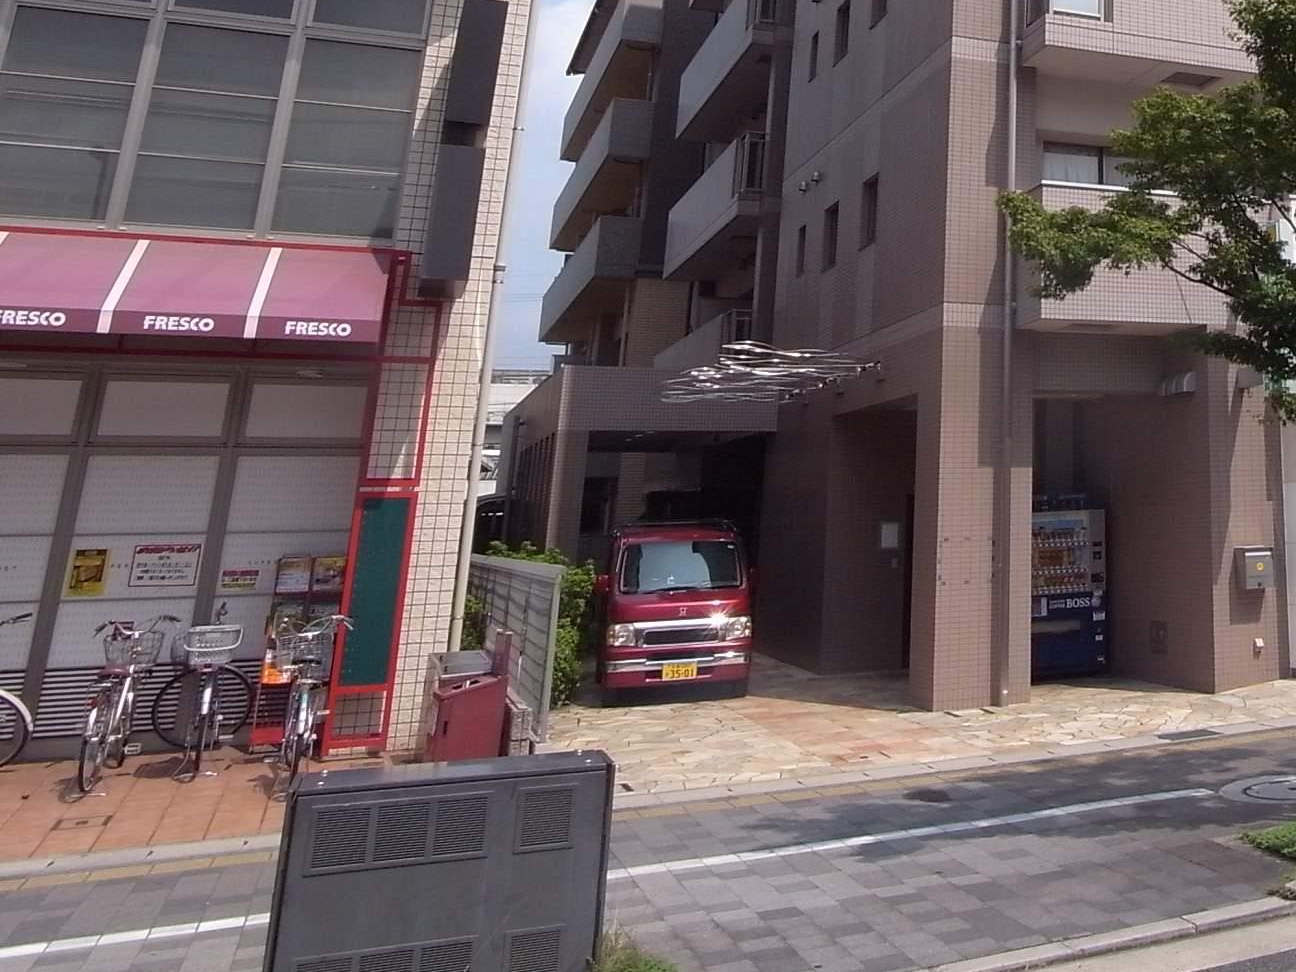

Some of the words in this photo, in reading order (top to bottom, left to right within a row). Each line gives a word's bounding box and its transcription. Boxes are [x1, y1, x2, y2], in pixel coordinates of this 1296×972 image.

[0, 309, 66, 327] RESCO
[143, 315, 215, 331] FRESCO
[285, 321, 352, 337] FRESCO
[1066, 597, 1090, 609] BOSS
